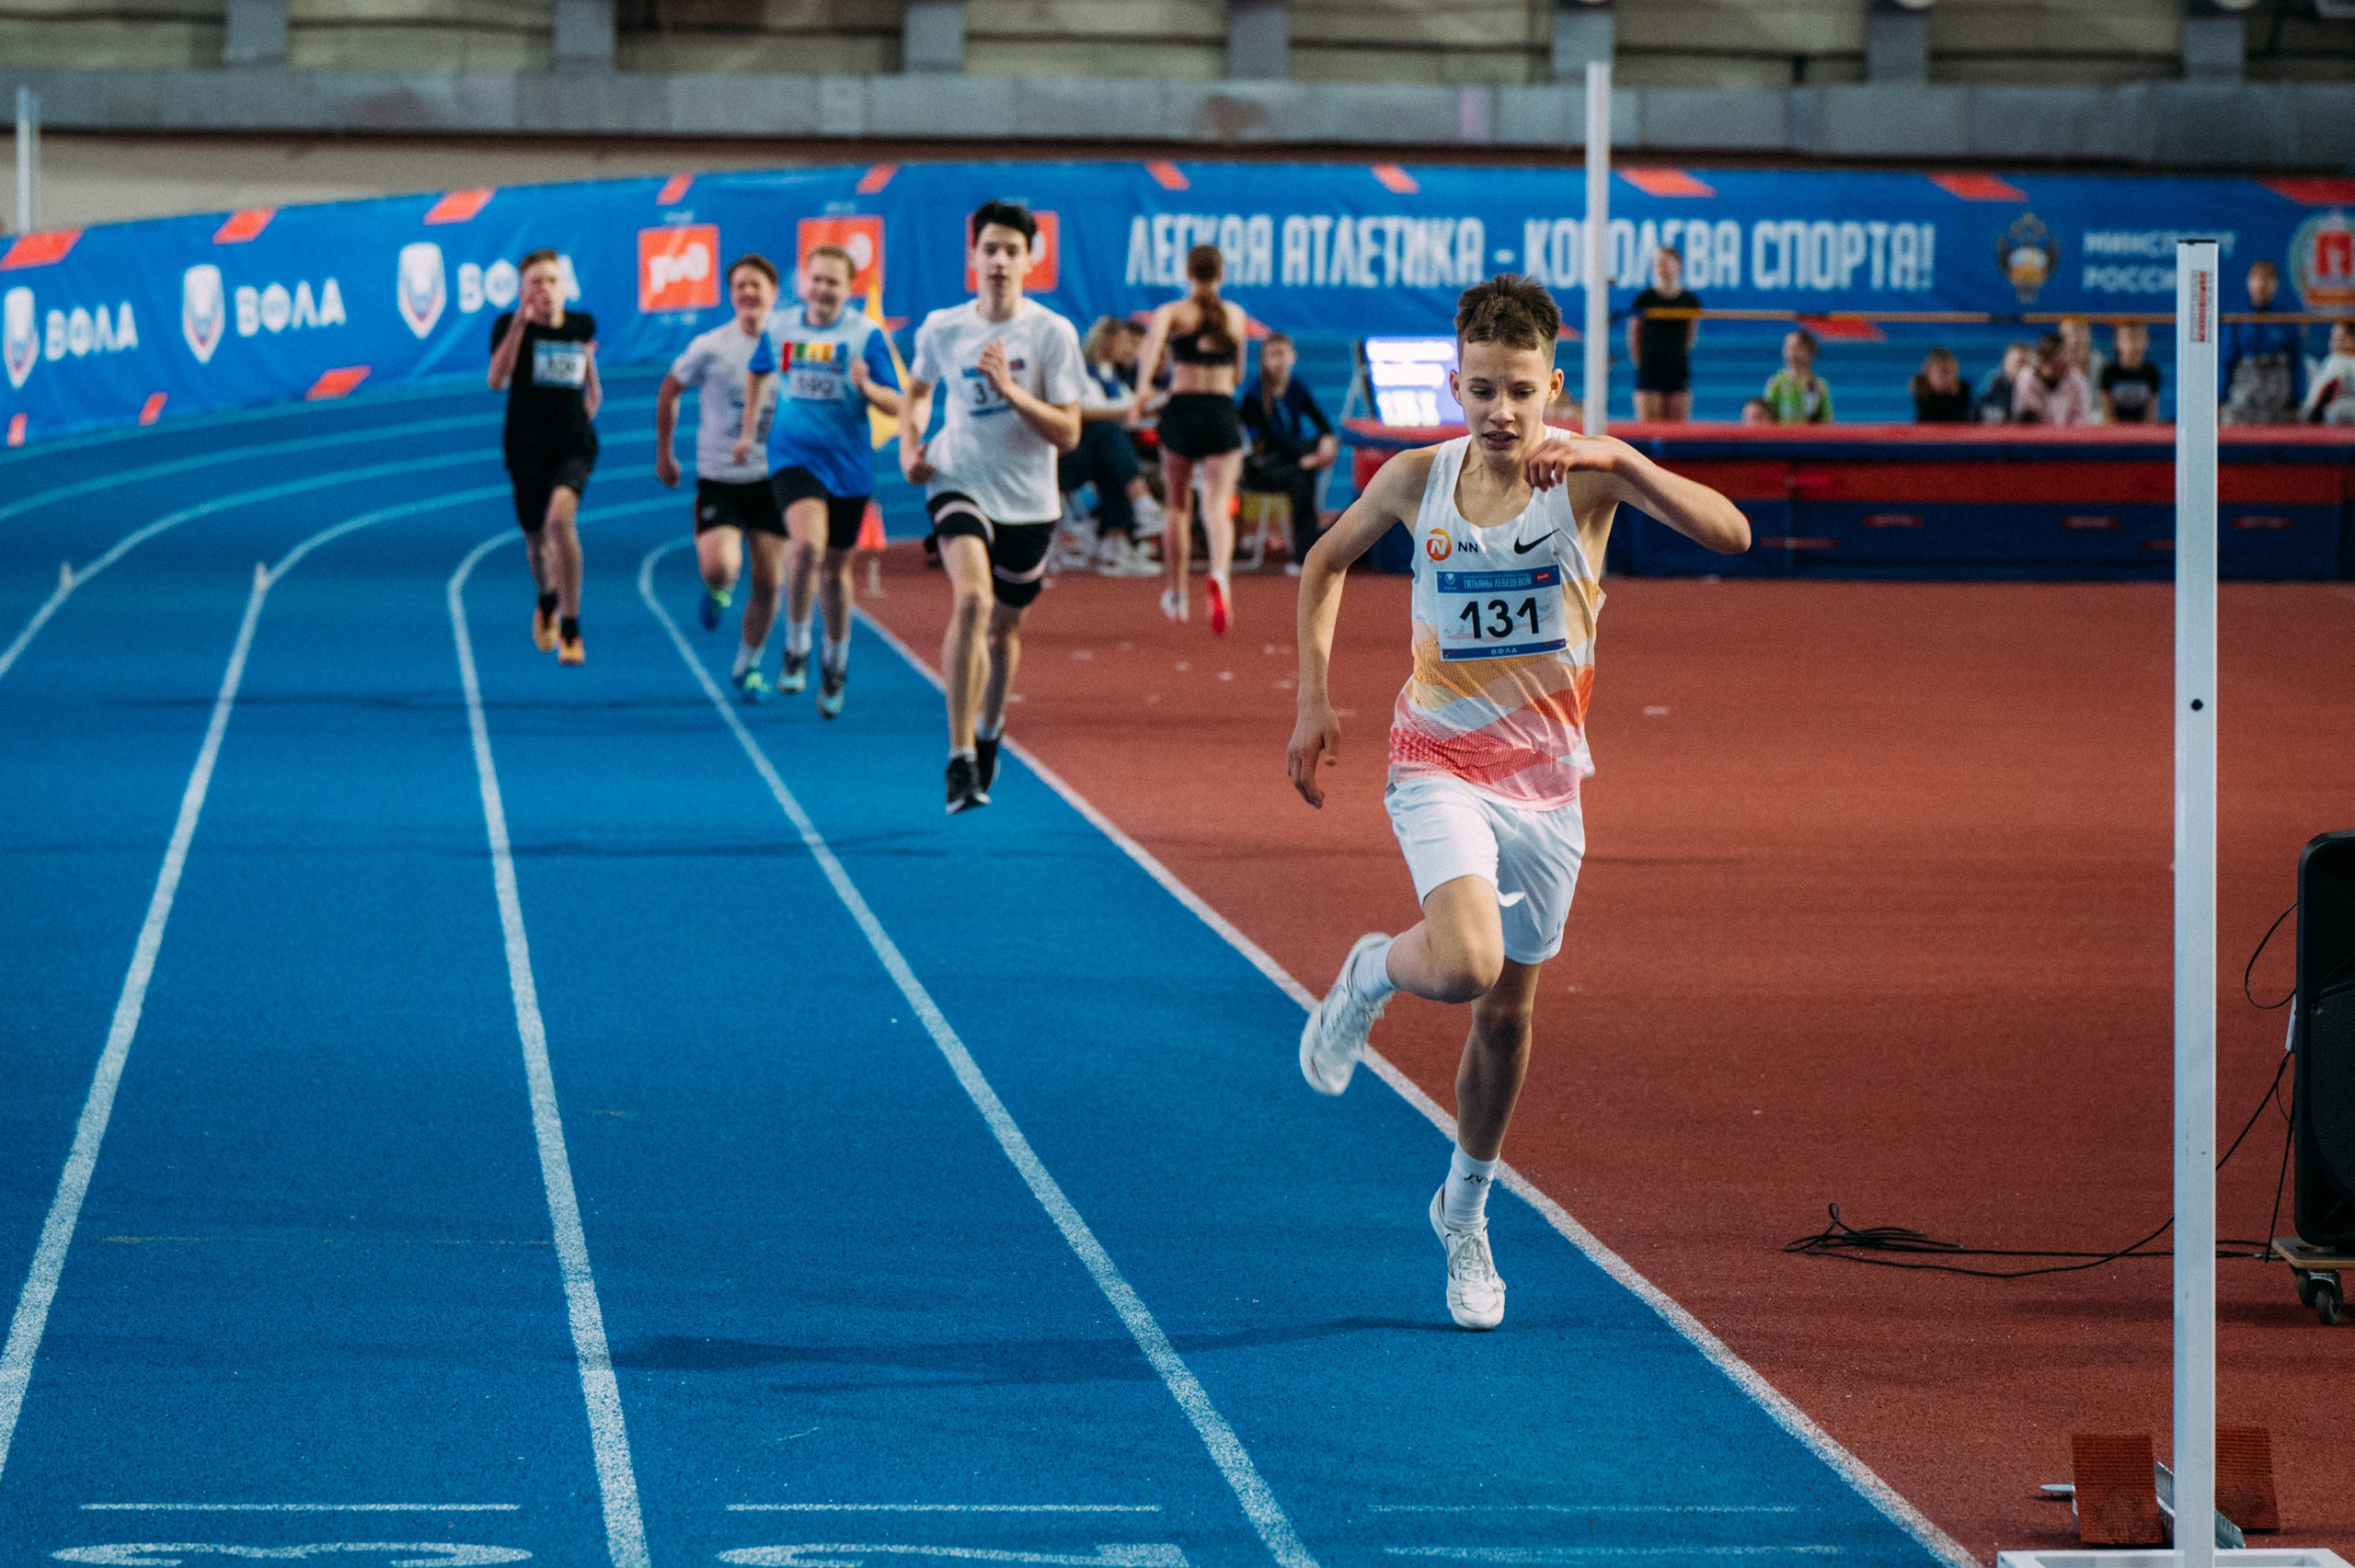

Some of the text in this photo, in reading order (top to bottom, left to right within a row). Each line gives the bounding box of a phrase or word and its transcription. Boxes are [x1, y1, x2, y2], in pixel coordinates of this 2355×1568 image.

[1282, 214, 1485, 288] АТЛЕТИКА
[1752, 220, 1936, 292] СПОРТА!
[1458, 541, 1478, 553] NN
[1464, 579, 1493, 589] ТАТЬЯНЫ
[1459, 597, 1540, 639] 131
